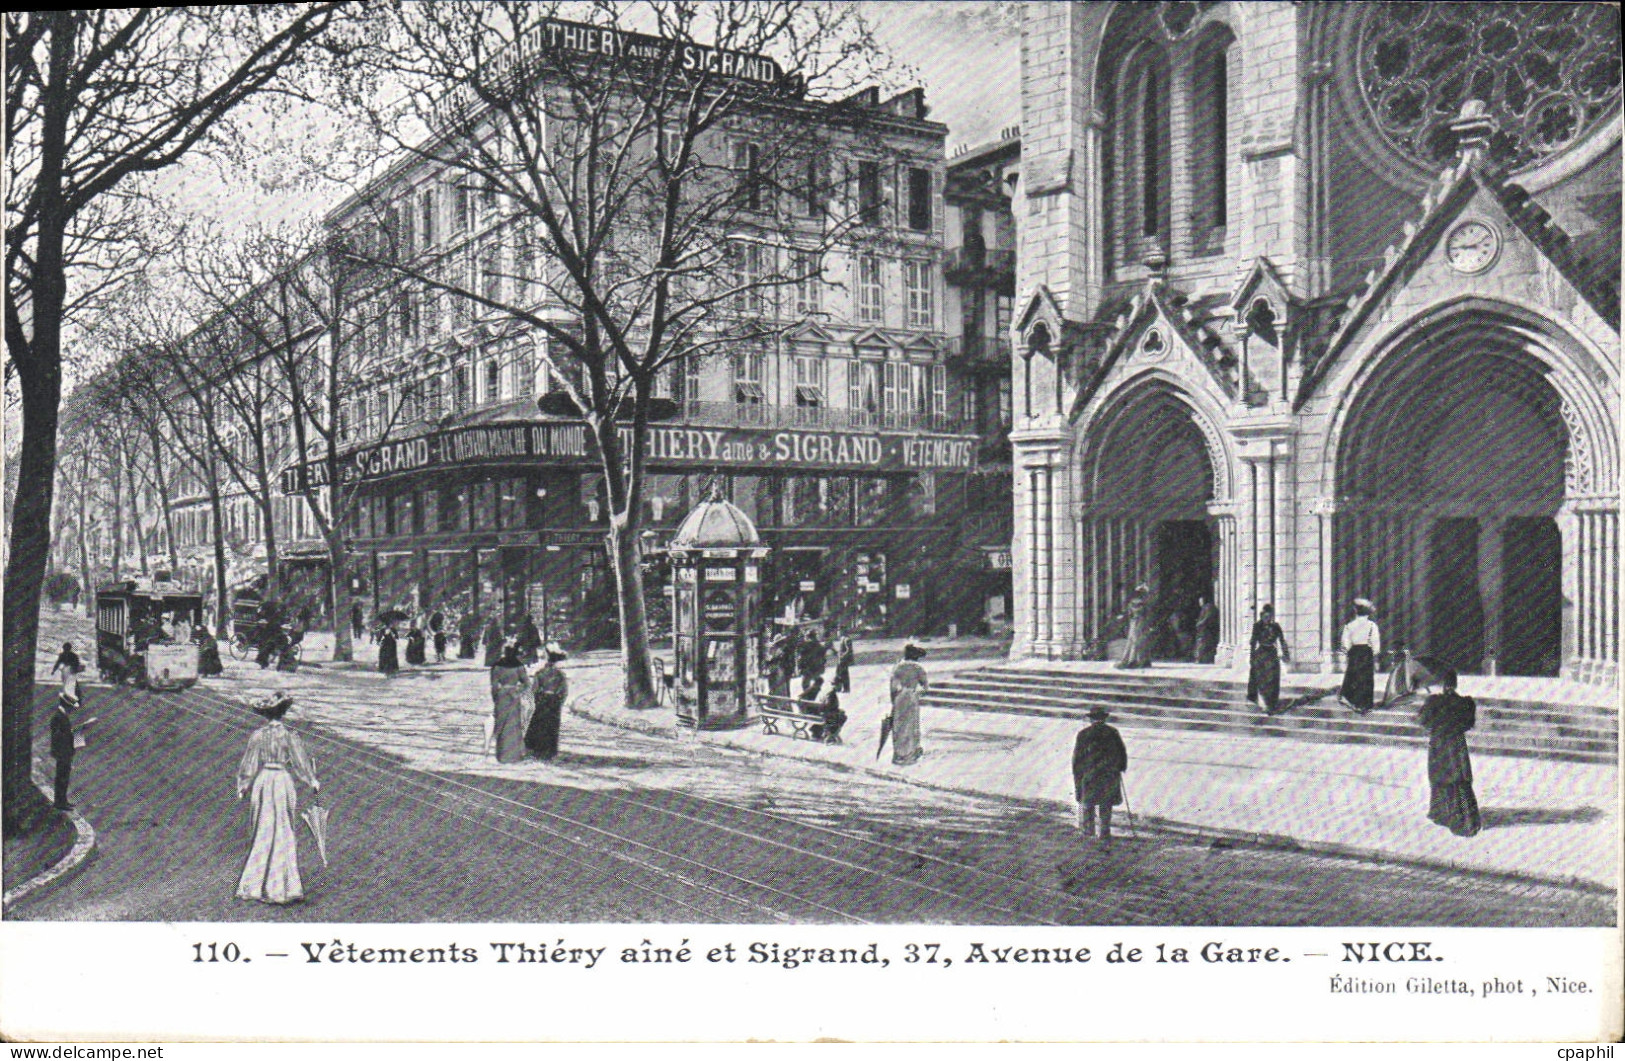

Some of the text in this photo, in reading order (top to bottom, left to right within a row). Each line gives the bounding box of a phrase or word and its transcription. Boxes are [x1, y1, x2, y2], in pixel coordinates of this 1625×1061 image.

[682, 46, 774, 82] SIGRAND
[532, 426, 547, 455] DU
[551, 426, 587, 456] MONDE
[775, 433, 882, 464] SIGRAND
